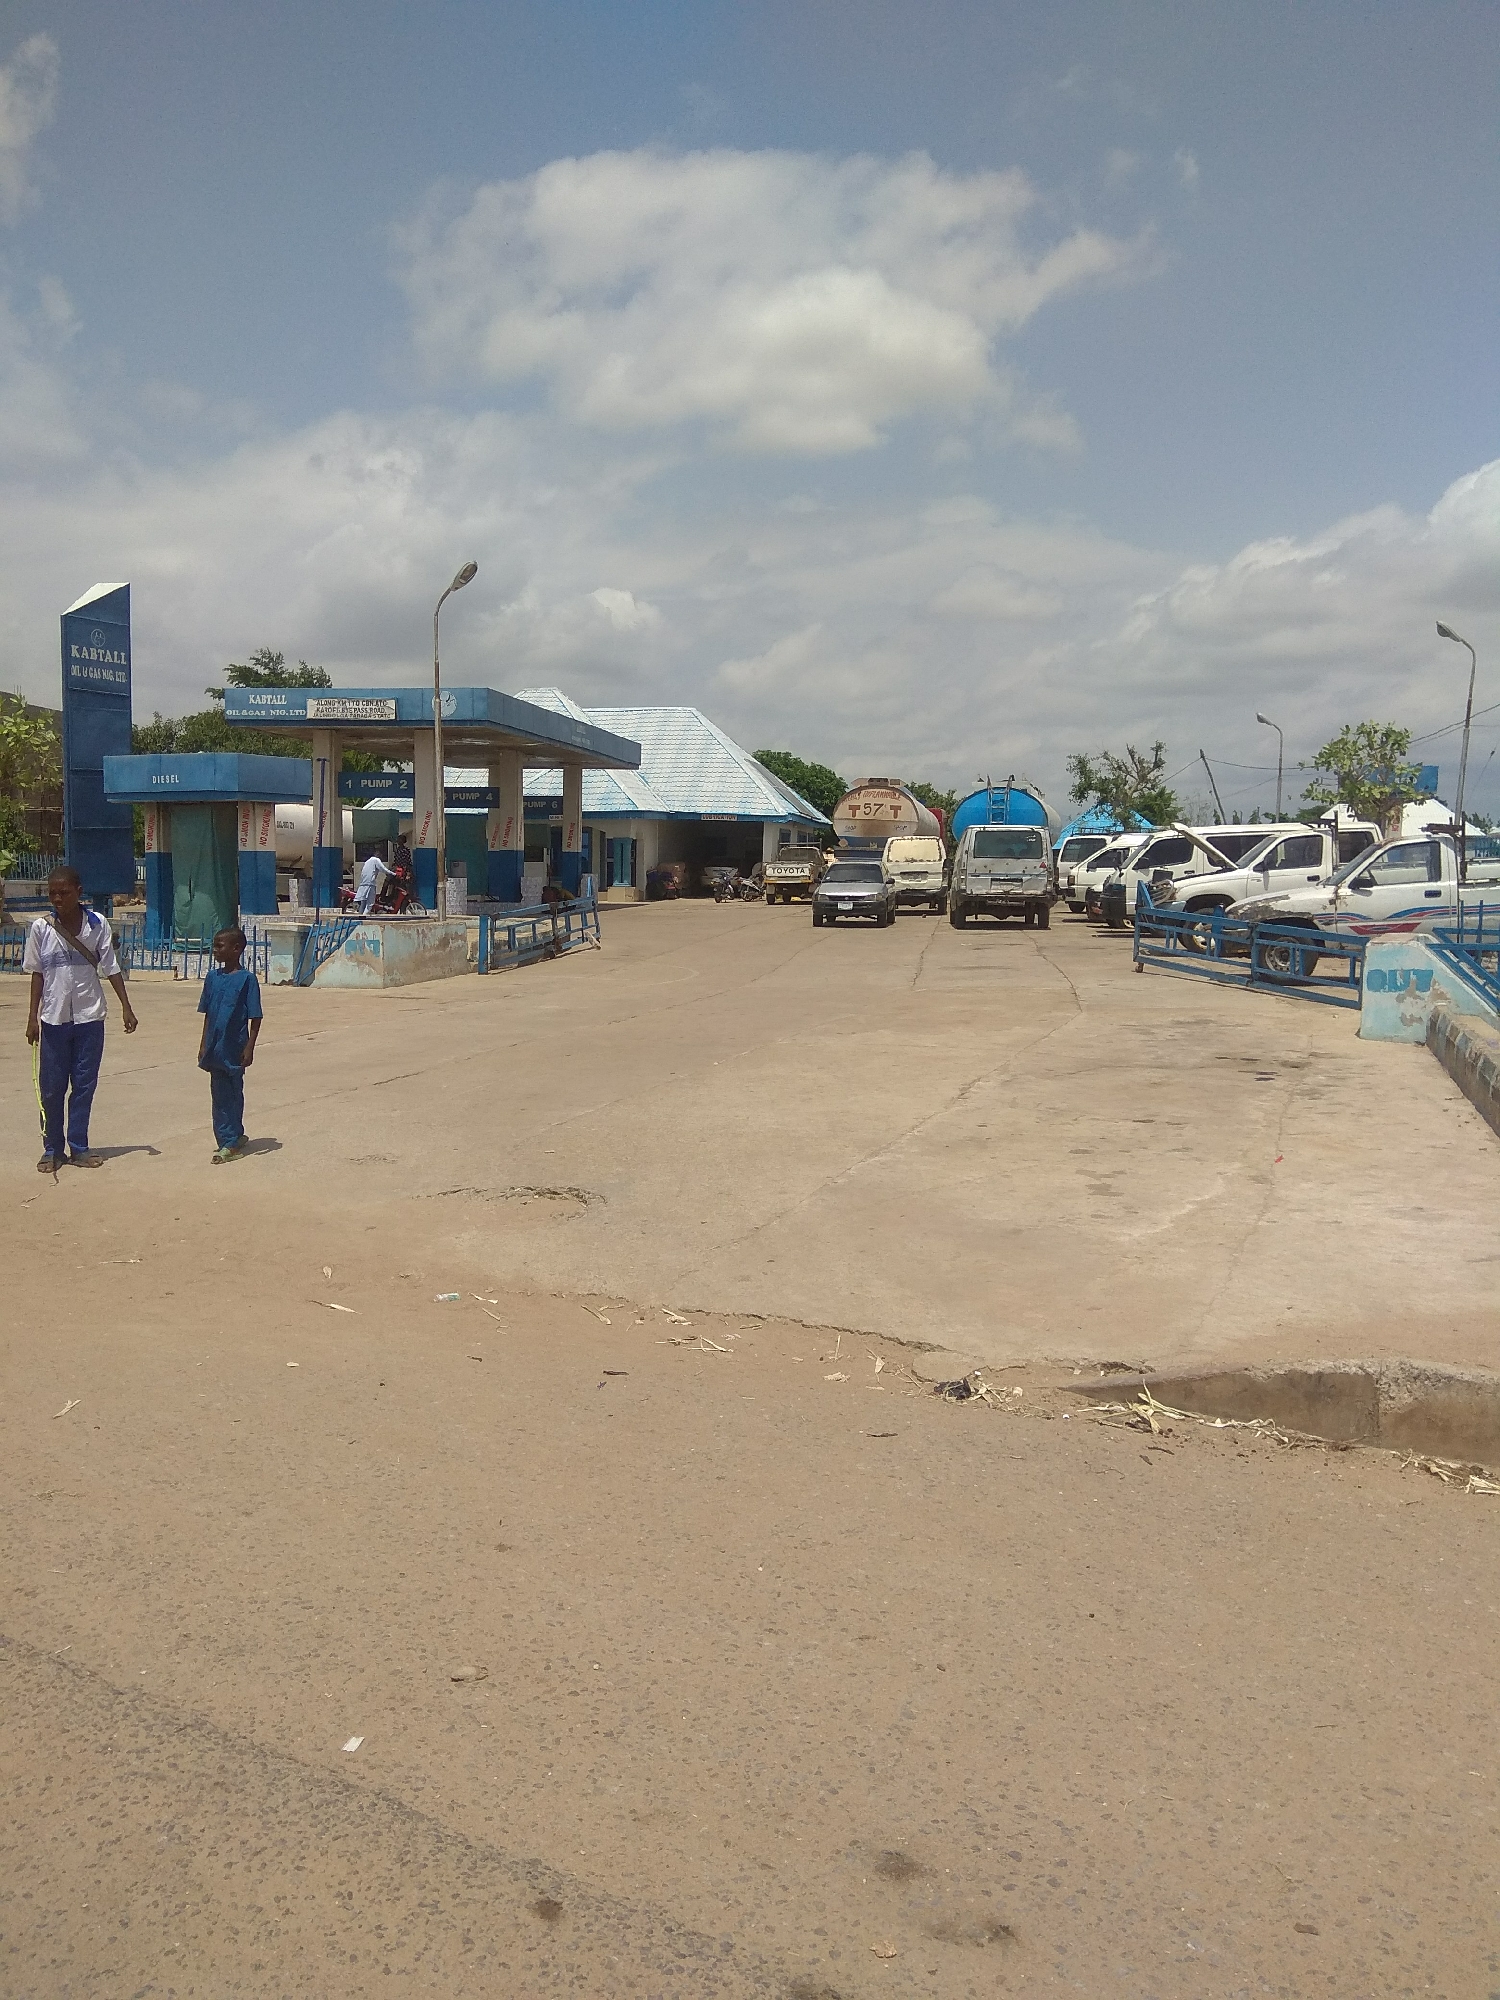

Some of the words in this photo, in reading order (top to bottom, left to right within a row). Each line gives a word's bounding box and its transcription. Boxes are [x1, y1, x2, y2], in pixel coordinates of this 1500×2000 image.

[71, 645, 127, 664] KABTALL
[249, 695, 287, 704] KABTALL
[152, 775, 179, 784] DIESEL
[346, 780, 352, 788] 1
[361, 780, 392, 788] PUMP
[400, 780, 408, 789] 2
[453, 793, 480, 801] PUMP
[486, 793, 493, 801] 4
[552, 801, 559, 809] 6
[849, 805, 861, 818] T
[863, 803, 885, 816] 57
[890, 805, 902, 819] T
[1366, 969, 1434, 992] OUT
